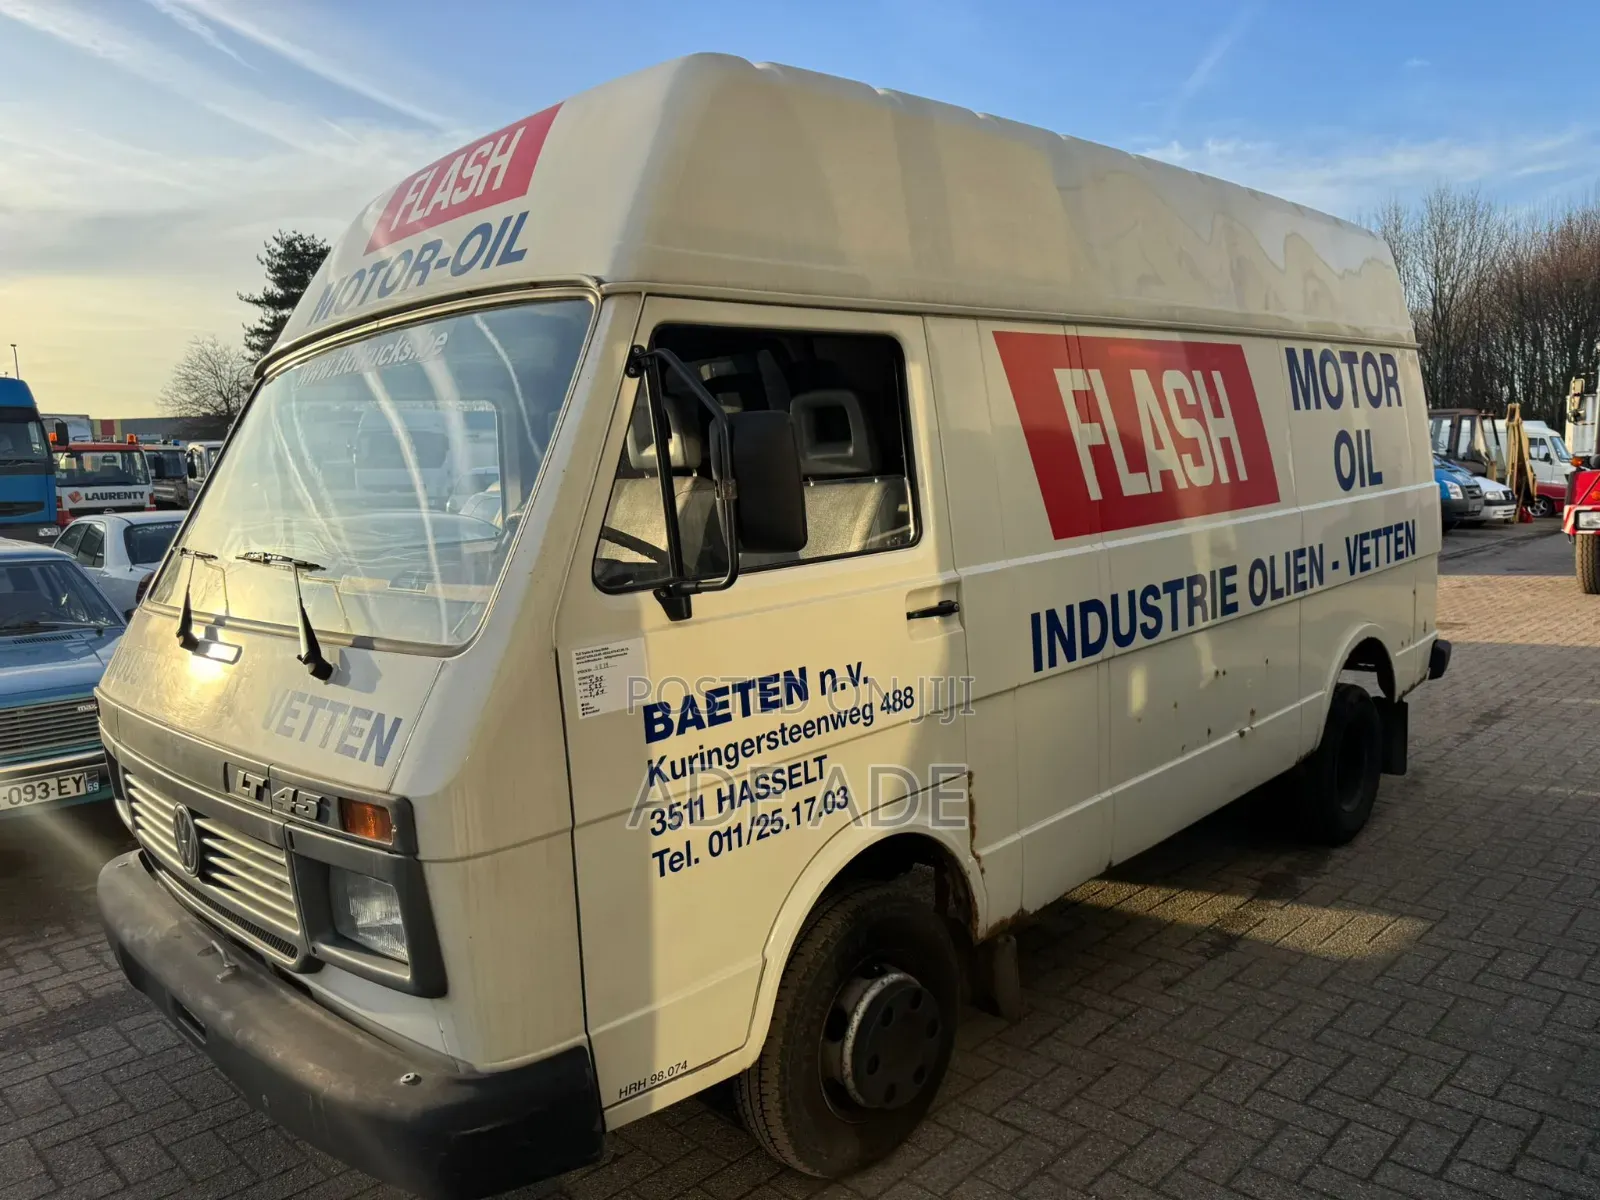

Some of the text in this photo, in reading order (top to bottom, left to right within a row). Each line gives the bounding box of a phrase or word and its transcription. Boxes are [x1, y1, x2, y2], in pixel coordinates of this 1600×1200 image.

[389, 126, 526, 232] FLASH
[308, 210, 530, 326] MOTOR-OIL
[1285, 347, 1402, 410] MOTOR
[1053, 368, 1248, 501] FLASH
[1334, 428, 1383, 491] OIL
[85, 491, 145, 500] LAURENTY
[1031, 564, 1239, 673] INDUSTRIE
[1249, 543, 1324, 607] OLIEN
[1345, 519, 1416, 577] VETTEN
[262, 688, 403, 768] VETTEN
[643, 662, 869, 744] BAETEN n.v.
[647, 686, 915, 787] Kuringersteenweg 488
[0, 775, 84, 807] -093-EY
[87, 782, 99, 792] 69
[235, 769, 324, 821] LT 45
[650, 755, 828, 837] 3511 HASSELT
[652, 786, 849, 878] Tel. 011/25.17.03
[619, 1060, 688, 1099] HRH 98.074
